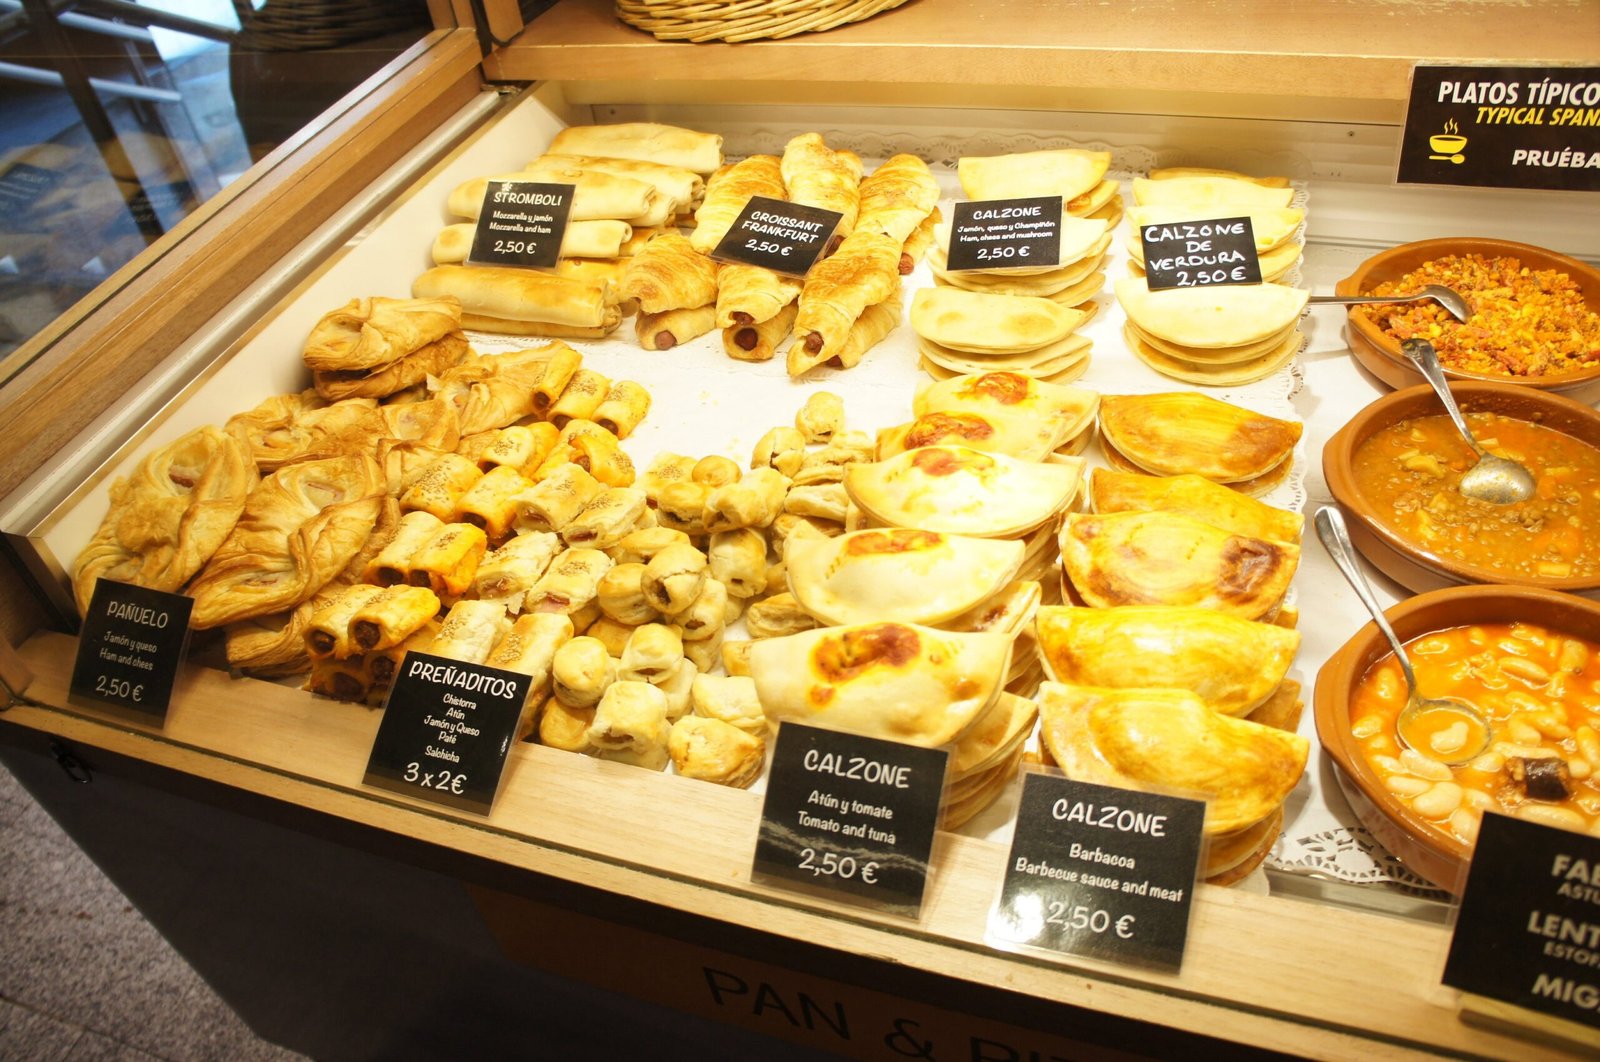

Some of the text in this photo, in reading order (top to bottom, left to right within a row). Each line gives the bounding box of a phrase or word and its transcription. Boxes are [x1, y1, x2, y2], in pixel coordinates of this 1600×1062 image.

[1437, 81, 1520, 105] PLATOS
[1475, 106, 1600, 127] TYPICAL SPAN
[493, 191, 562, 206] STROMBOLI
[493, 210, 528, 221] Mozzarella
[532, 213, 554, 223] jamón
[751, 211, 823, 232] CROISSANT
[973, 206, 1042, 220] CALZONE
[489, 222, 552, 234] Mozzarella and ham
[741, 220, 819, 244] FRANKFURT
[1001, 231, 1016, 240] and
[1016, 231, 1053, 239] mushroom
[1144, 223, 1245, 242] CALZONE
[493, 240, 537, 254] 2,50 €
[745, 238, 793, 256] 2,50 €
[976, 245, 1031, 261] 2,50 €
[1185, 240, 1213, 253] DE
[1150, 249, 1246, 271] VERDURA
[107, 600, 169, 629] PAÑUELO
[103, 630, 158, 654] Jamón y queso
[99, 647, 154, 671] Ham and chees
[95, 675, 144, 702] 2,50 €
[408, 660, 517, 699] PREÑADITOS
[442, 692, 477, 710] Chistorra
[445, 707, 466, 720] Atún
[423, 714, 480, 737] Jamón y Queso
[438, 731, 458, 745] Paté
[424, 745, 460, 763] Salchicha
[803, 749, 912, 789] CALZONE
[807, 790, 893, 820] Atún y tomate
[797, 810, 897, 845] Tomato and tuna
[1052, 798, 1168, 837] CALZONE
[798, 848, 880, 885] 2,50 €
[1069, 843, 1136, 869] Barbacoa
[1015, 857, 1184, 902] Barbecue sauce and meat
[1046, 901, 1136, 938] 2,50 €
[1531, 973, 1600, 1014] MIG
[702, 966, 850, 1040] PAN
[884, 1017, 936, 1062] &
